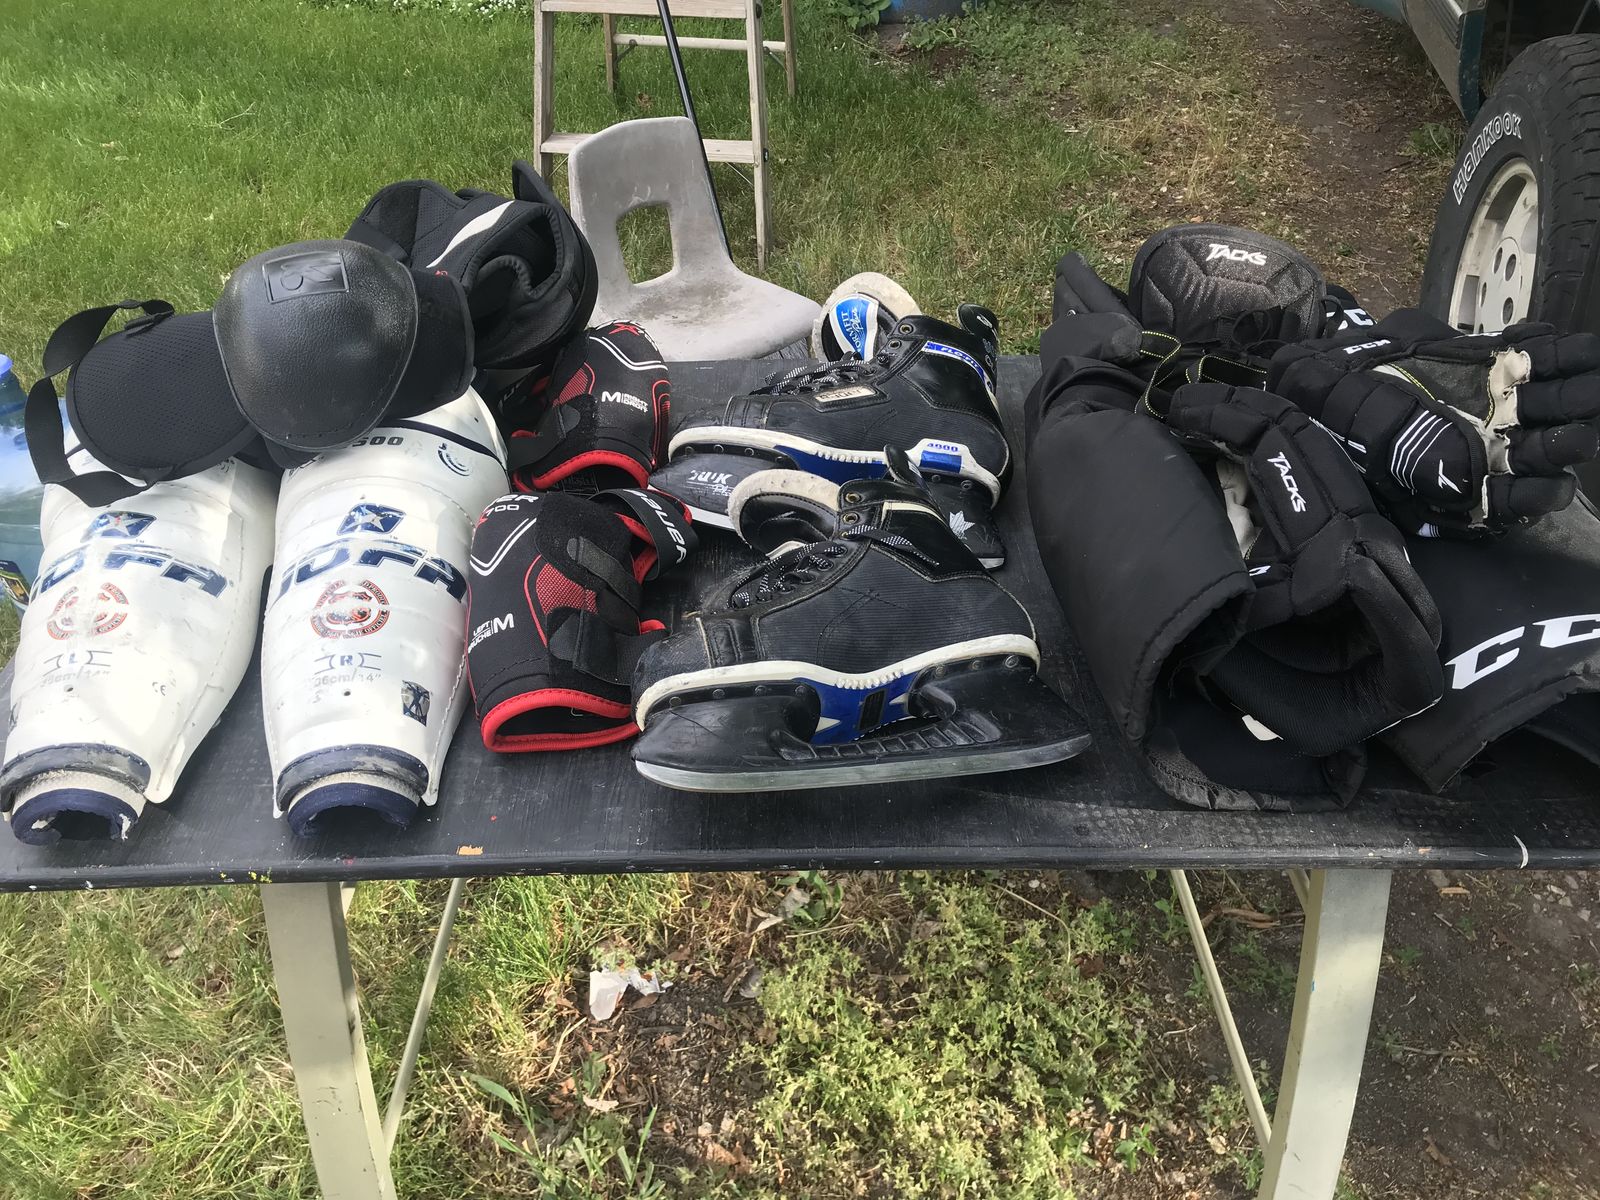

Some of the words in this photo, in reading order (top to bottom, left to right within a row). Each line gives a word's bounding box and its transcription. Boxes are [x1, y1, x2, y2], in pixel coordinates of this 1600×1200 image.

[1205, 243, 1268, 266] TACKS
[1342, 339, 1392, 355] CCM
[1266, 451, 1307, 513] TACKS
[493, 612, 515, 634] M
